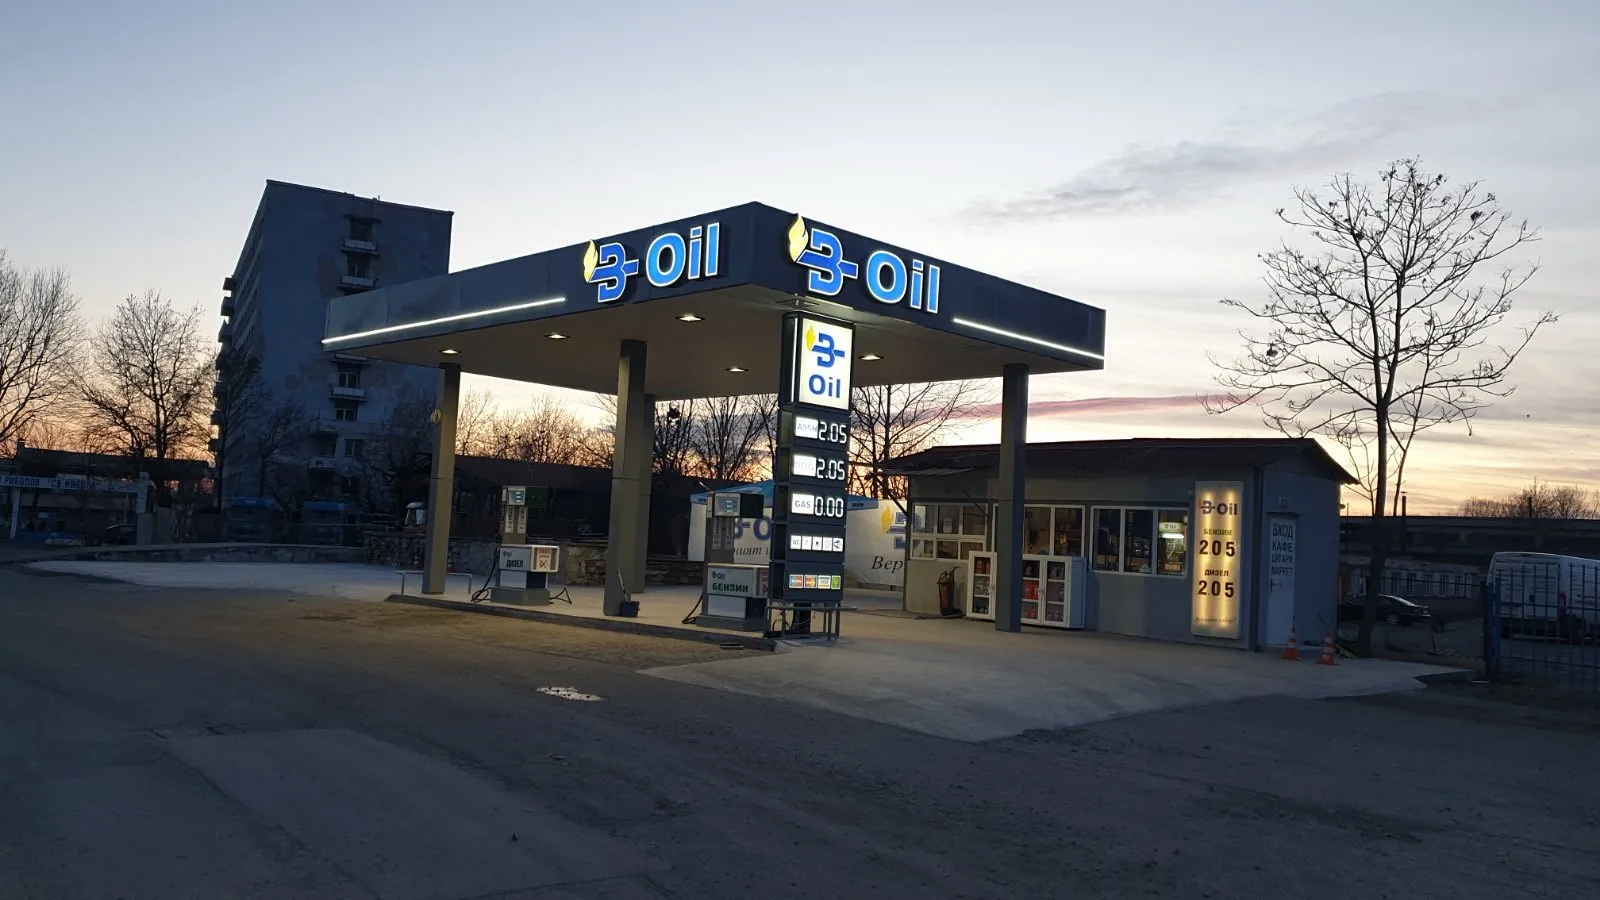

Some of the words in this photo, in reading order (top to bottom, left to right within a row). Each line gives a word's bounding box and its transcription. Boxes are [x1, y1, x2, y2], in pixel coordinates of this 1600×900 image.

[809, 374, 841, 399] Oil
[818, 421, 847, 444] 2.05
[816, 458, 845, 480] 2.05
[794, 499, 812, 509] GAS
[814, 496, 844, 518] 0.00
[1203, 528, 1233, 537] БЕНЗИН
[1272, 523, 1294, 540] ВХОД
[1272, 540, 1294, 553] КАФЕ
[506, 559, 524, 569] ДИЗЕЛ
[1204, 568, 1230, 578] ДИЗЕЛ
[712, 582, 749, 593] БЕНЗИН
